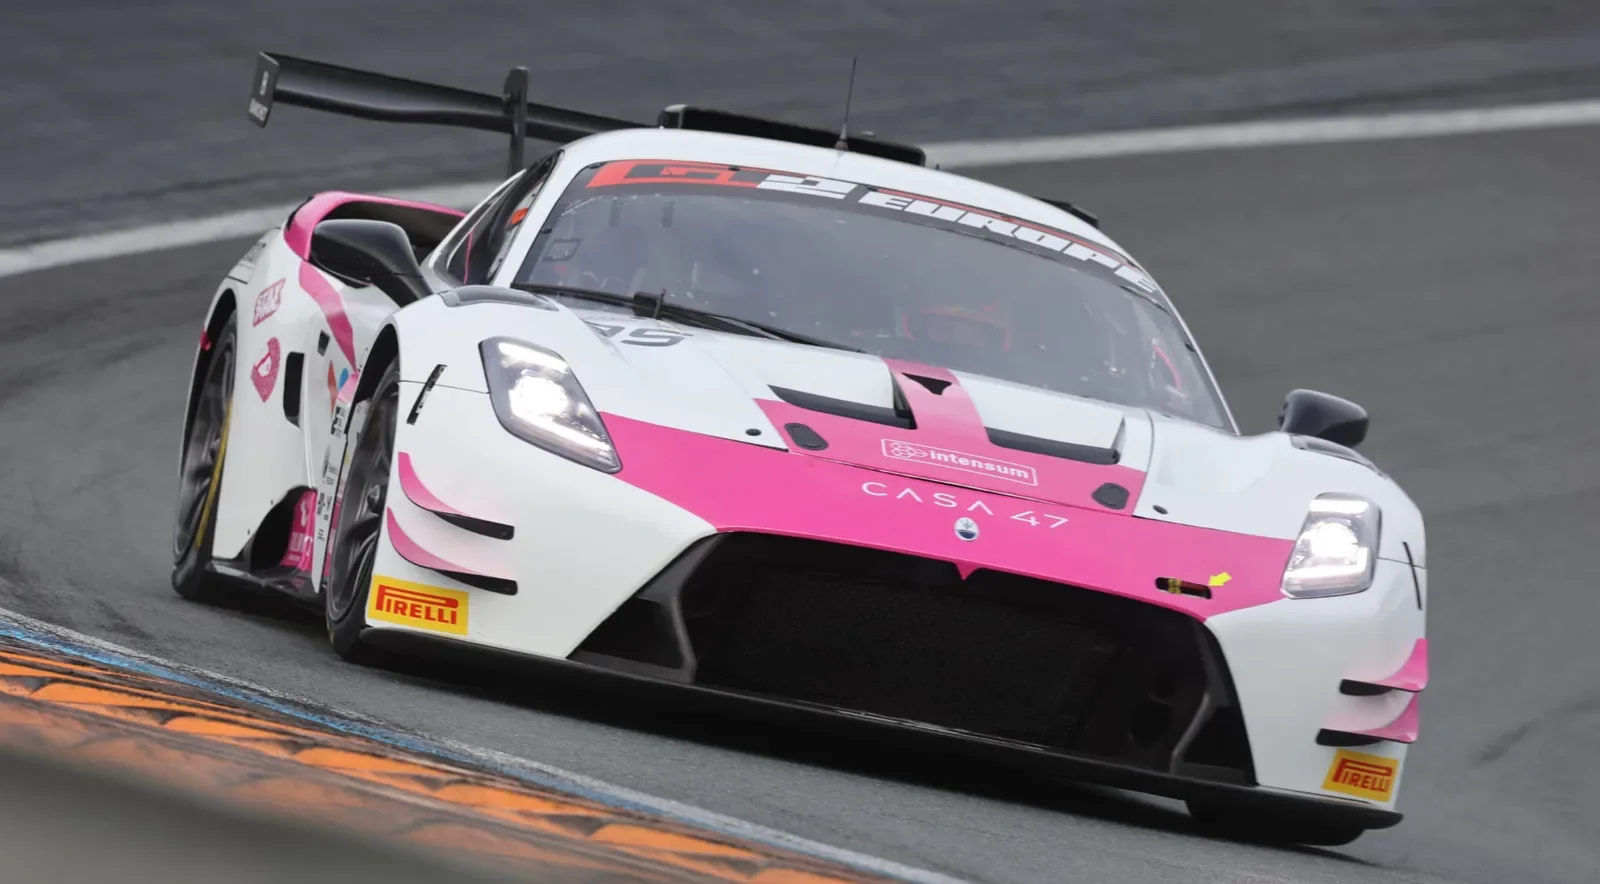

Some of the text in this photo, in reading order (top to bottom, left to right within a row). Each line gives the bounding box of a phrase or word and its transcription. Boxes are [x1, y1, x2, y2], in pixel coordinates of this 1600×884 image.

[858, 189, 1157, 293] EUROPE
[929, 449, 1030, 479] intensum
[861, 481, 1069, 529] CASA 47
[375, 584, 460, 626] PIRELLI
[1331, 757, 1394, 793] PIRELLI
